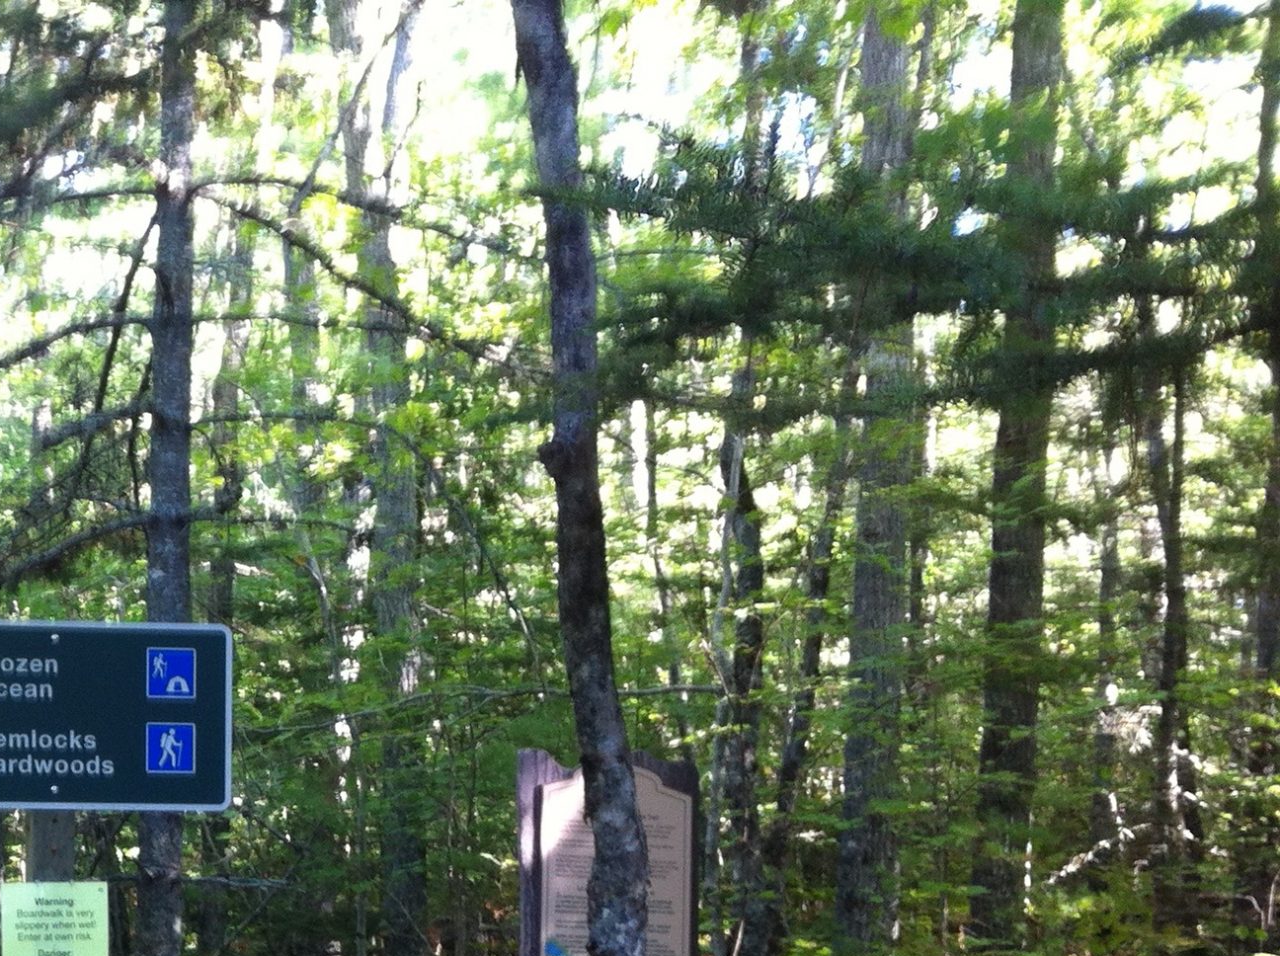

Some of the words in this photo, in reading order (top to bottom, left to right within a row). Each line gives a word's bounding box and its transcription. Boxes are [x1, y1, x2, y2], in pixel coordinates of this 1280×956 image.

[16, 909, 63, 918] Boardwalk
[65, 909, 73, 918] is
[76, 910, 94, 919] very
[15, 921, 49, 931] slippery
[51, 920, 75, 929] when
[17, 932, 41, 941] Enter
[43, 932, 53, 941] at
[54, 933, 74, 941] own
